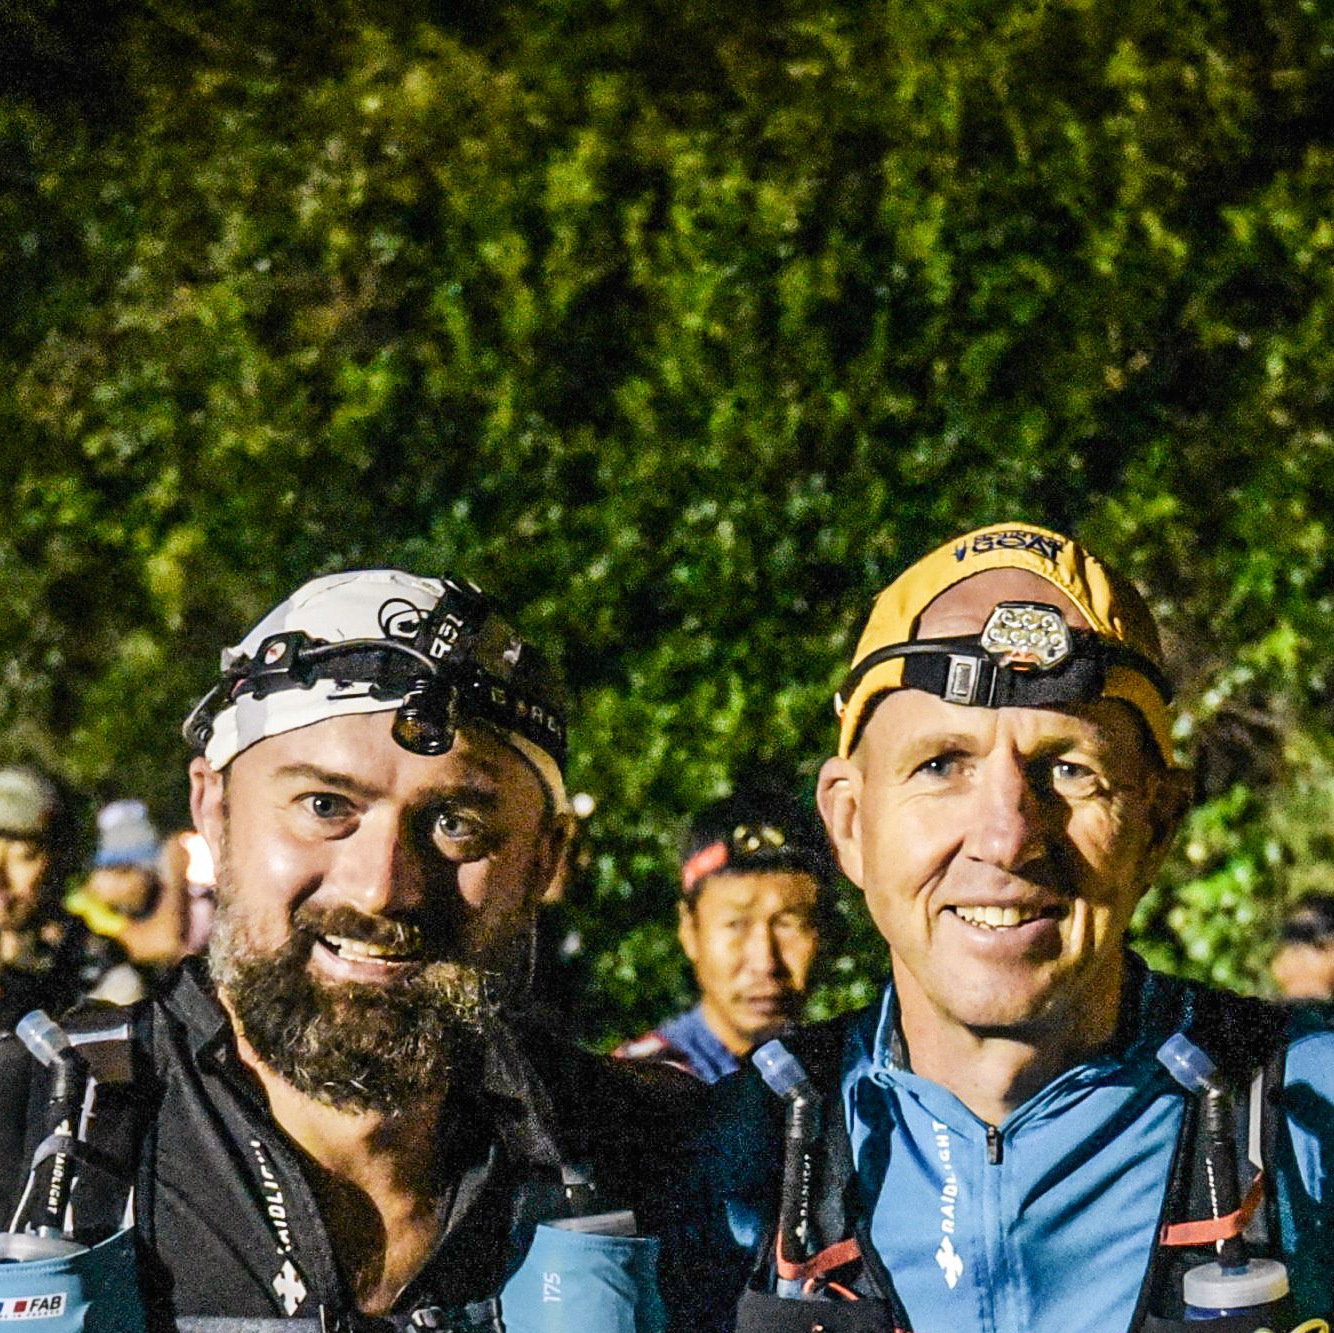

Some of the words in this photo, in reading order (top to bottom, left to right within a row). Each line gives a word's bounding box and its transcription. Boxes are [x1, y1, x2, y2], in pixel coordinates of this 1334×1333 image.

[932, 1121, 958, 1233] RAIDLIGHT
[543, 1271, 561, 1303] 175
[29, 1296, 62, 1312] FAB
